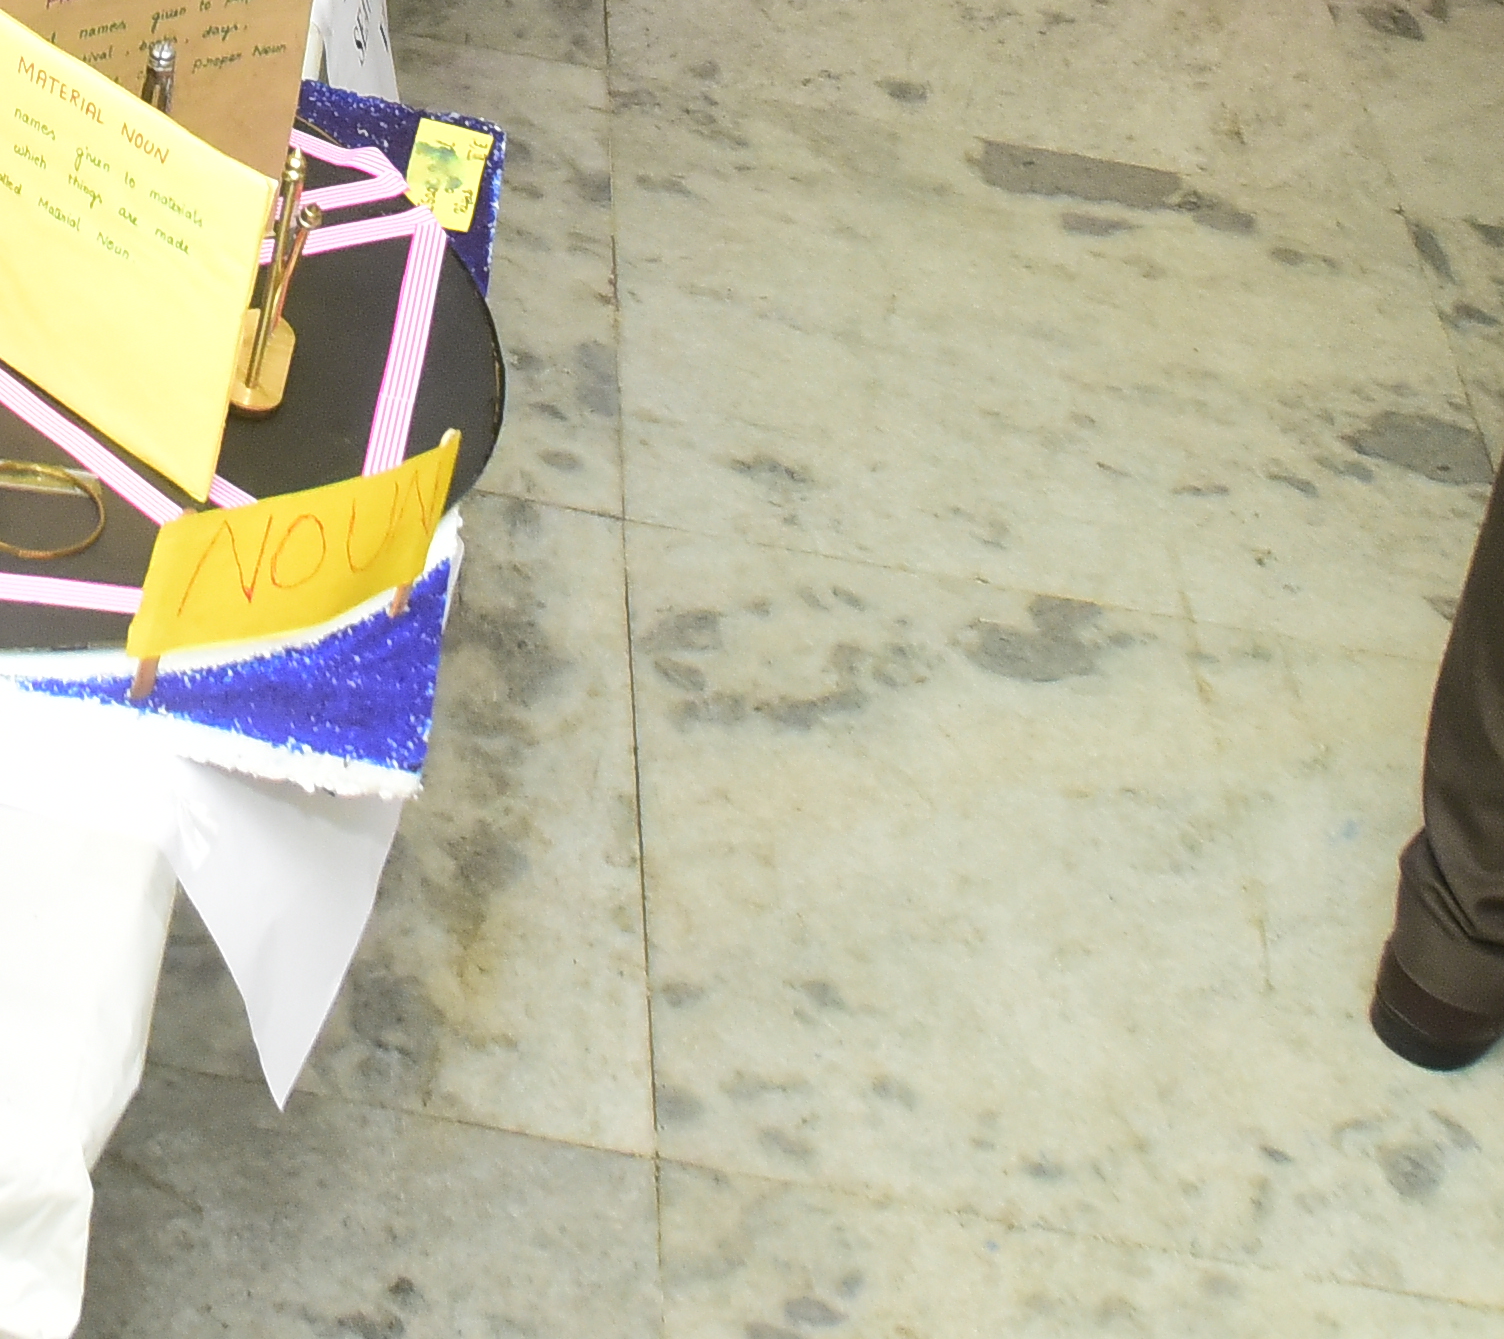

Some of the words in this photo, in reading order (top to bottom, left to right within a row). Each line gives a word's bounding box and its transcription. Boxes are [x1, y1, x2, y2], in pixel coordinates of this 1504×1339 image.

[79, 20, 126, 40] names
[151, 7, 187, 34] given
[18, 55, 105, 125] MATERIAL
[121, 122, 170, 164] NOUN
[13, 107, 57, 141] names
[124, 170, 136, 189] to
[149, 187, 204, 228] materials
[13, 143, 47, 170] which
[67, 172, 103, 210] things
[118, 206, 138, 227] are
[154, 226, 190, 255] made
[177, 460, 442, 617] NOUN
